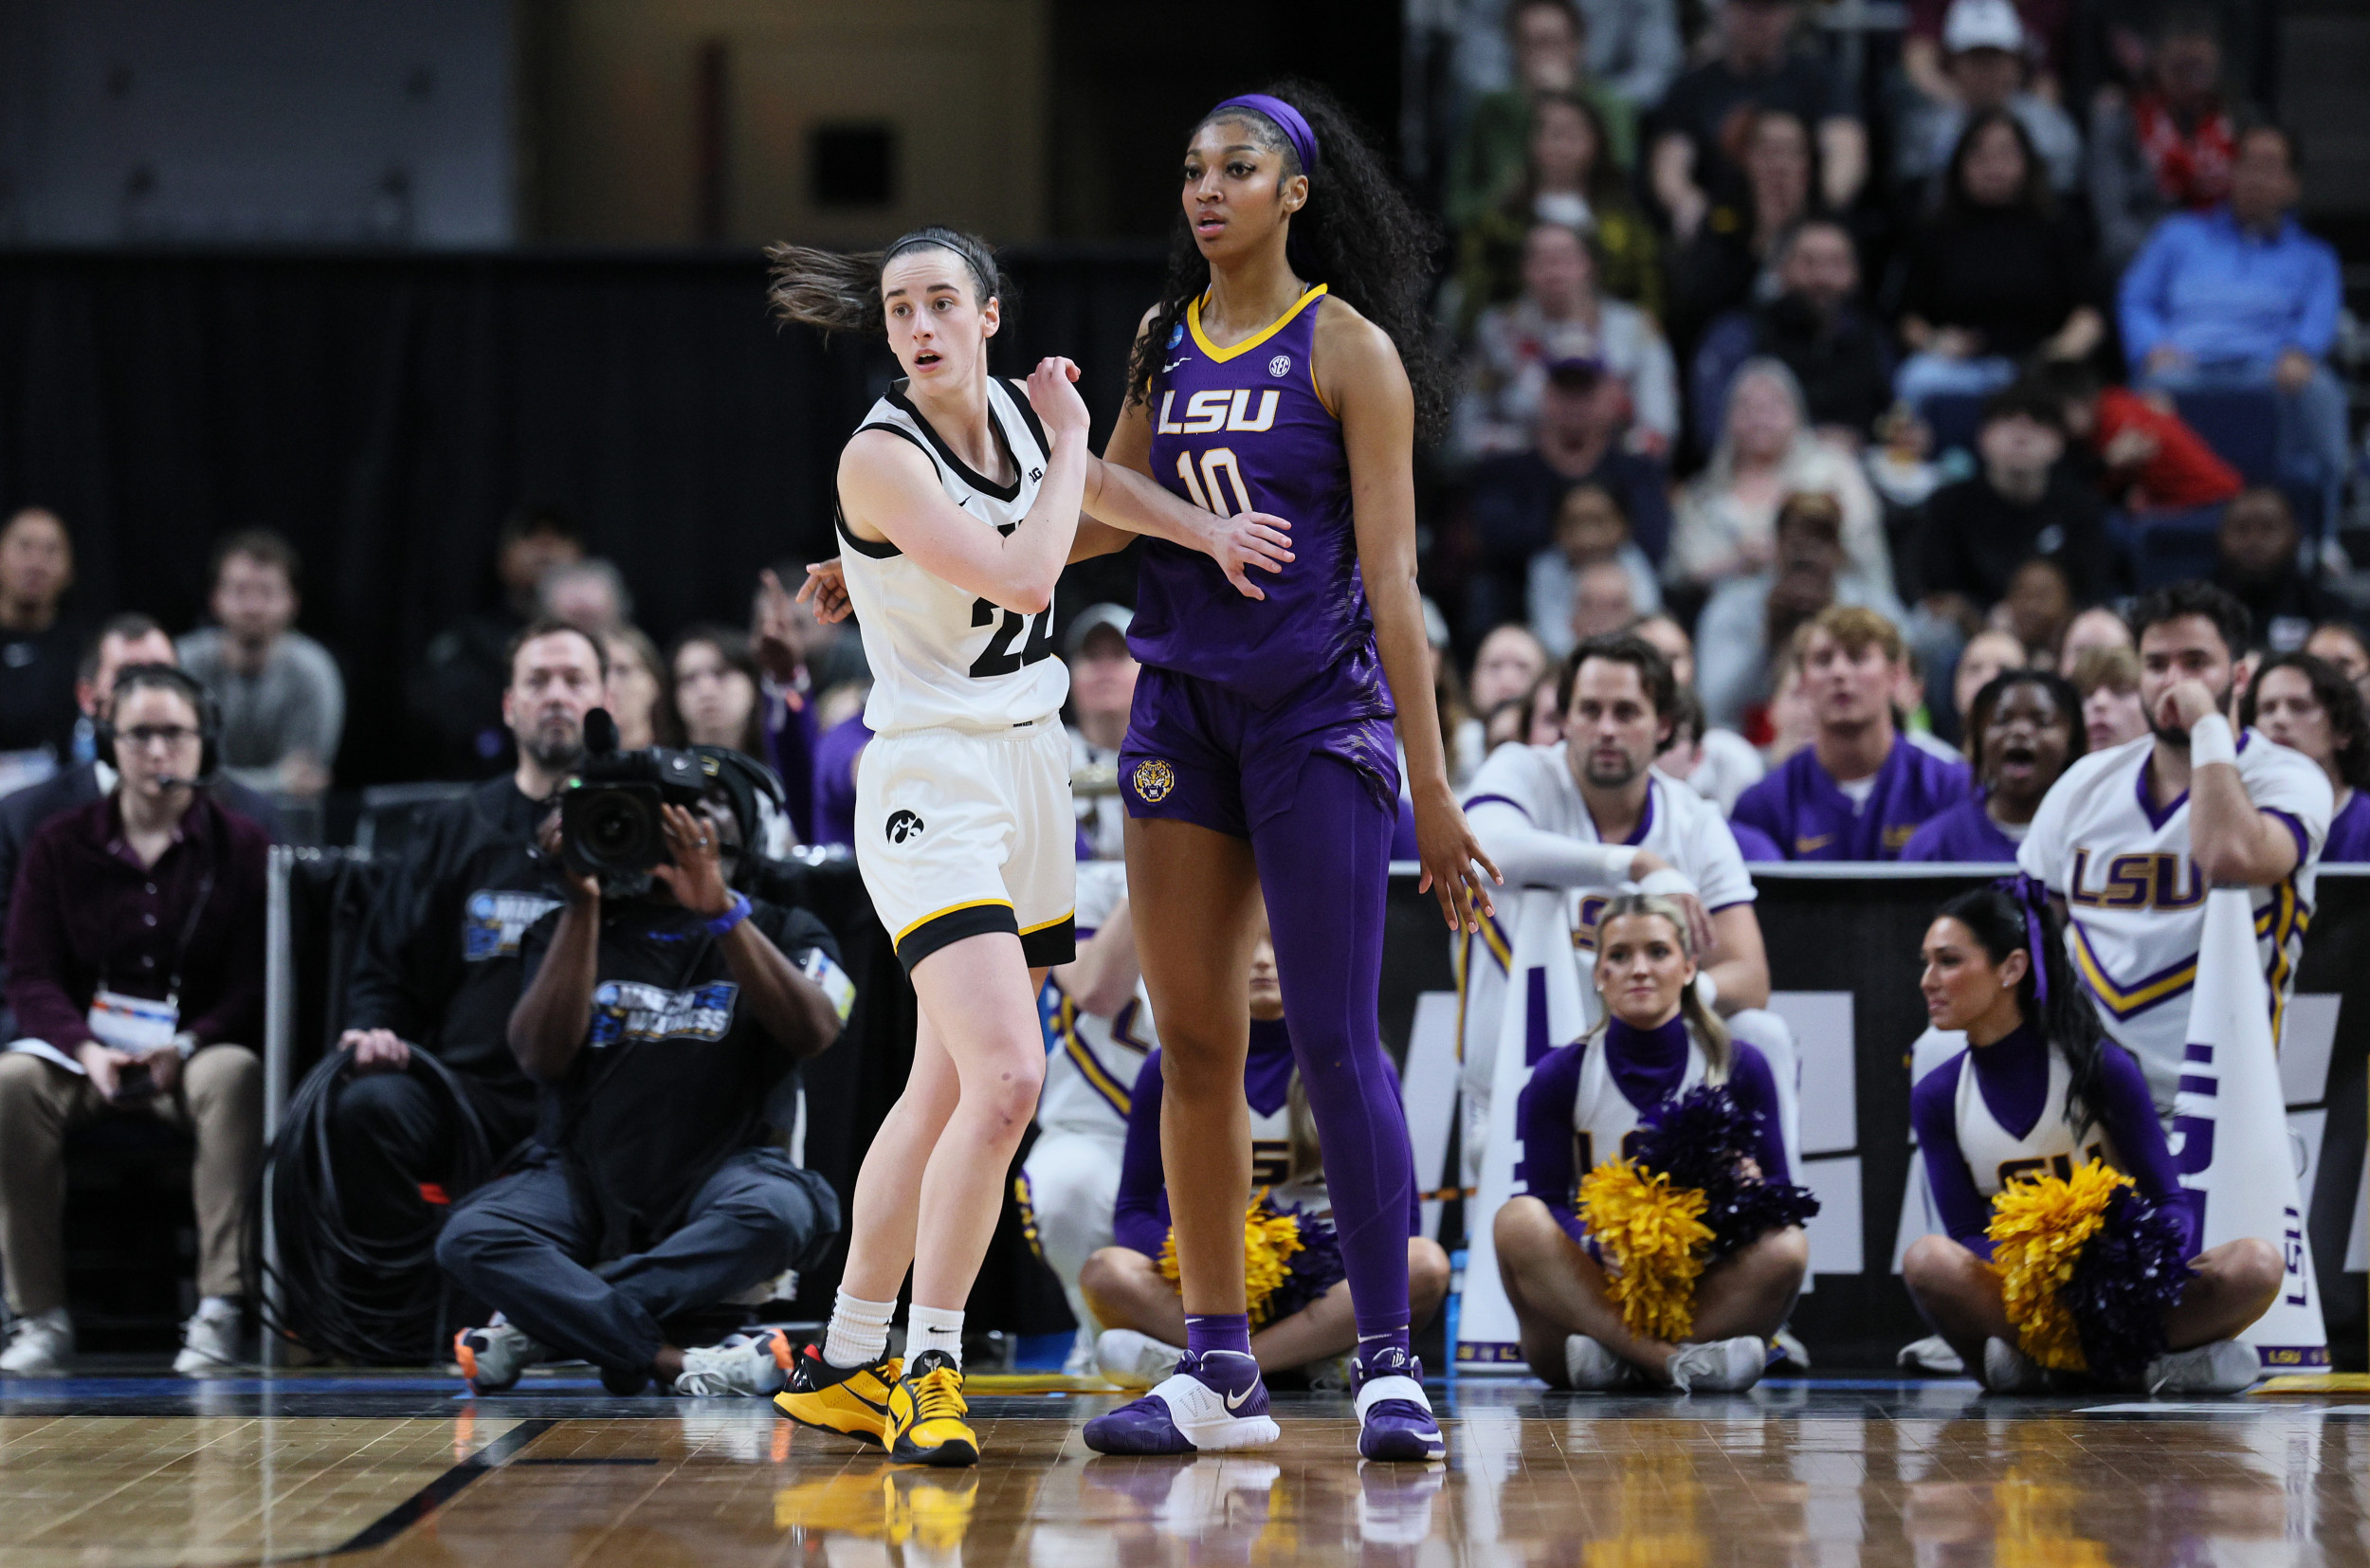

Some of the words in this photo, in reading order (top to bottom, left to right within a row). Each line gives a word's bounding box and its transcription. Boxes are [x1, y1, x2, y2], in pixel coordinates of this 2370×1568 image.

[1271, 357, 1289, 375] SEC
[1158, 389, 1280, 435] LSU
[1176, 447, 1253, 520] 10
[2072, 848, 2208, 911] LSU
